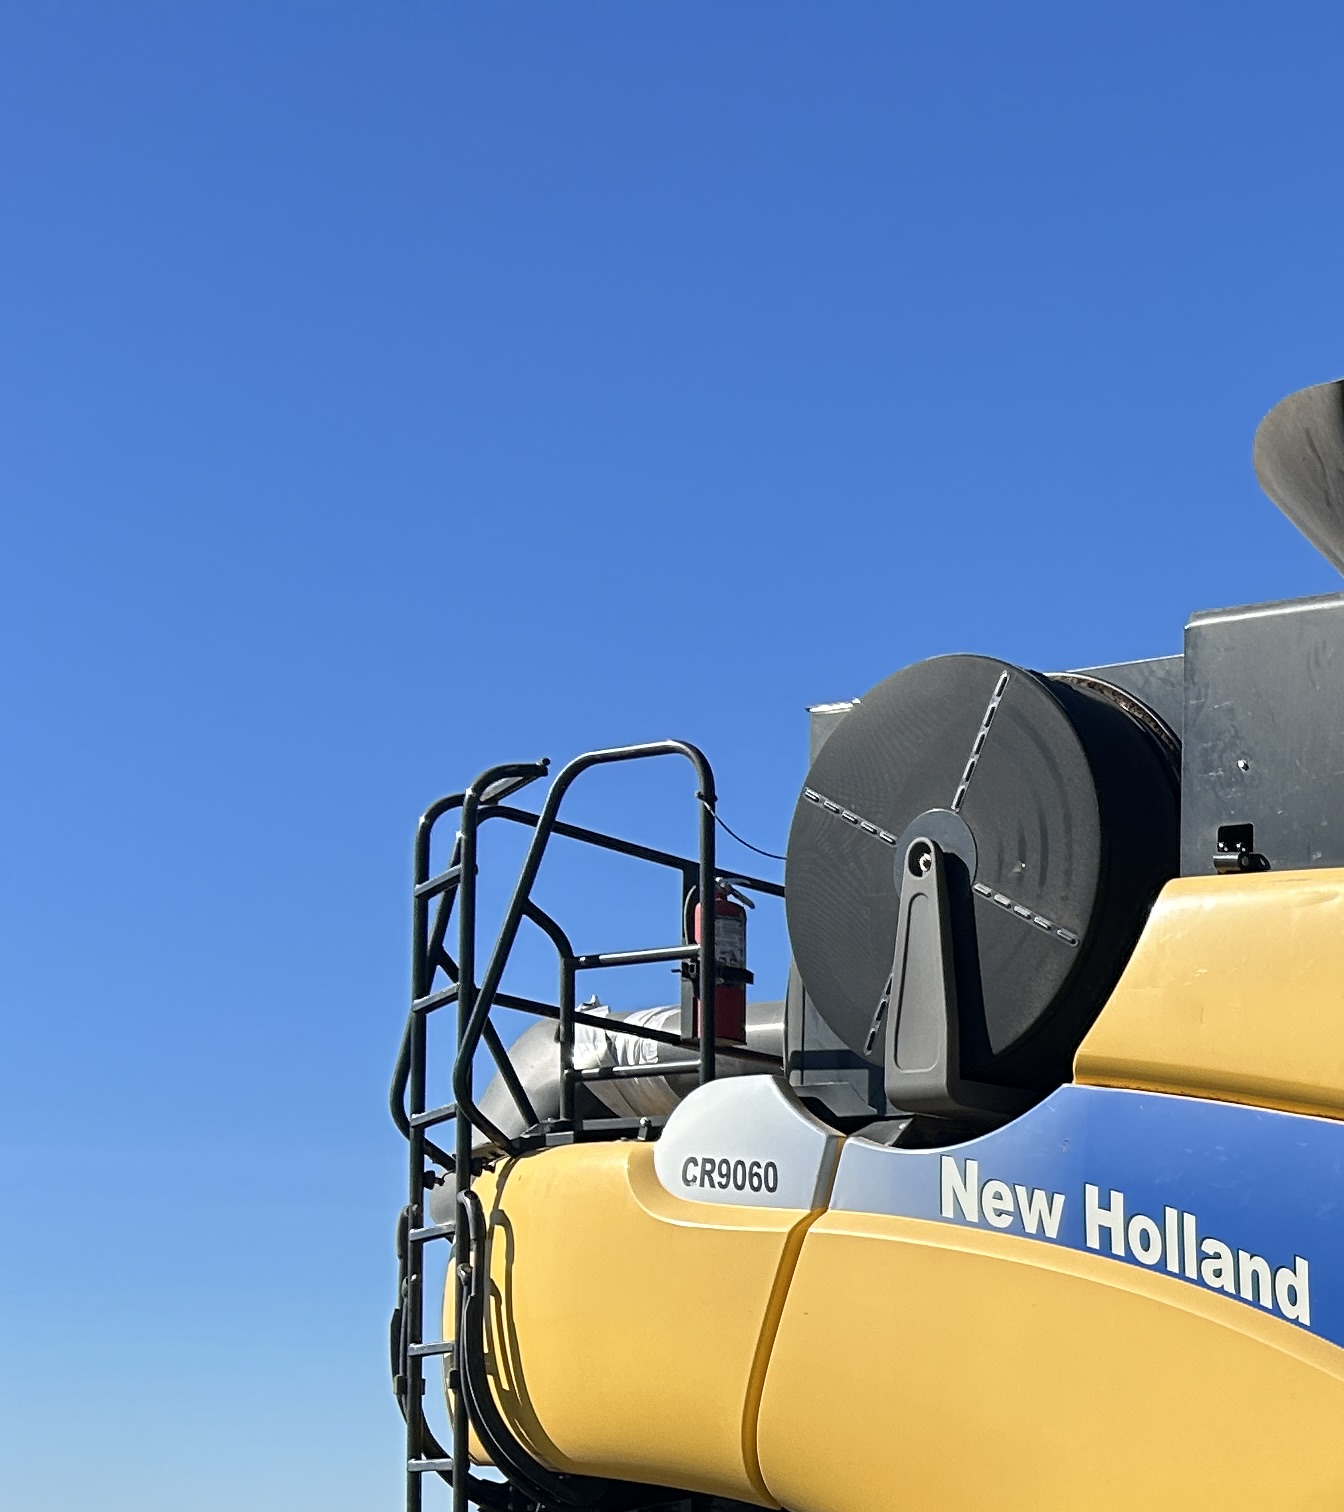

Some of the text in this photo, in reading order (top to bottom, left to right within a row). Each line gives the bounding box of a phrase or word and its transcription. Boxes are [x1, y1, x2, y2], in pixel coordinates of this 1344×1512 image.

[682, 1156, 778, 1193] CR9060
[940, 1154, 1310, 1326] New Holland
